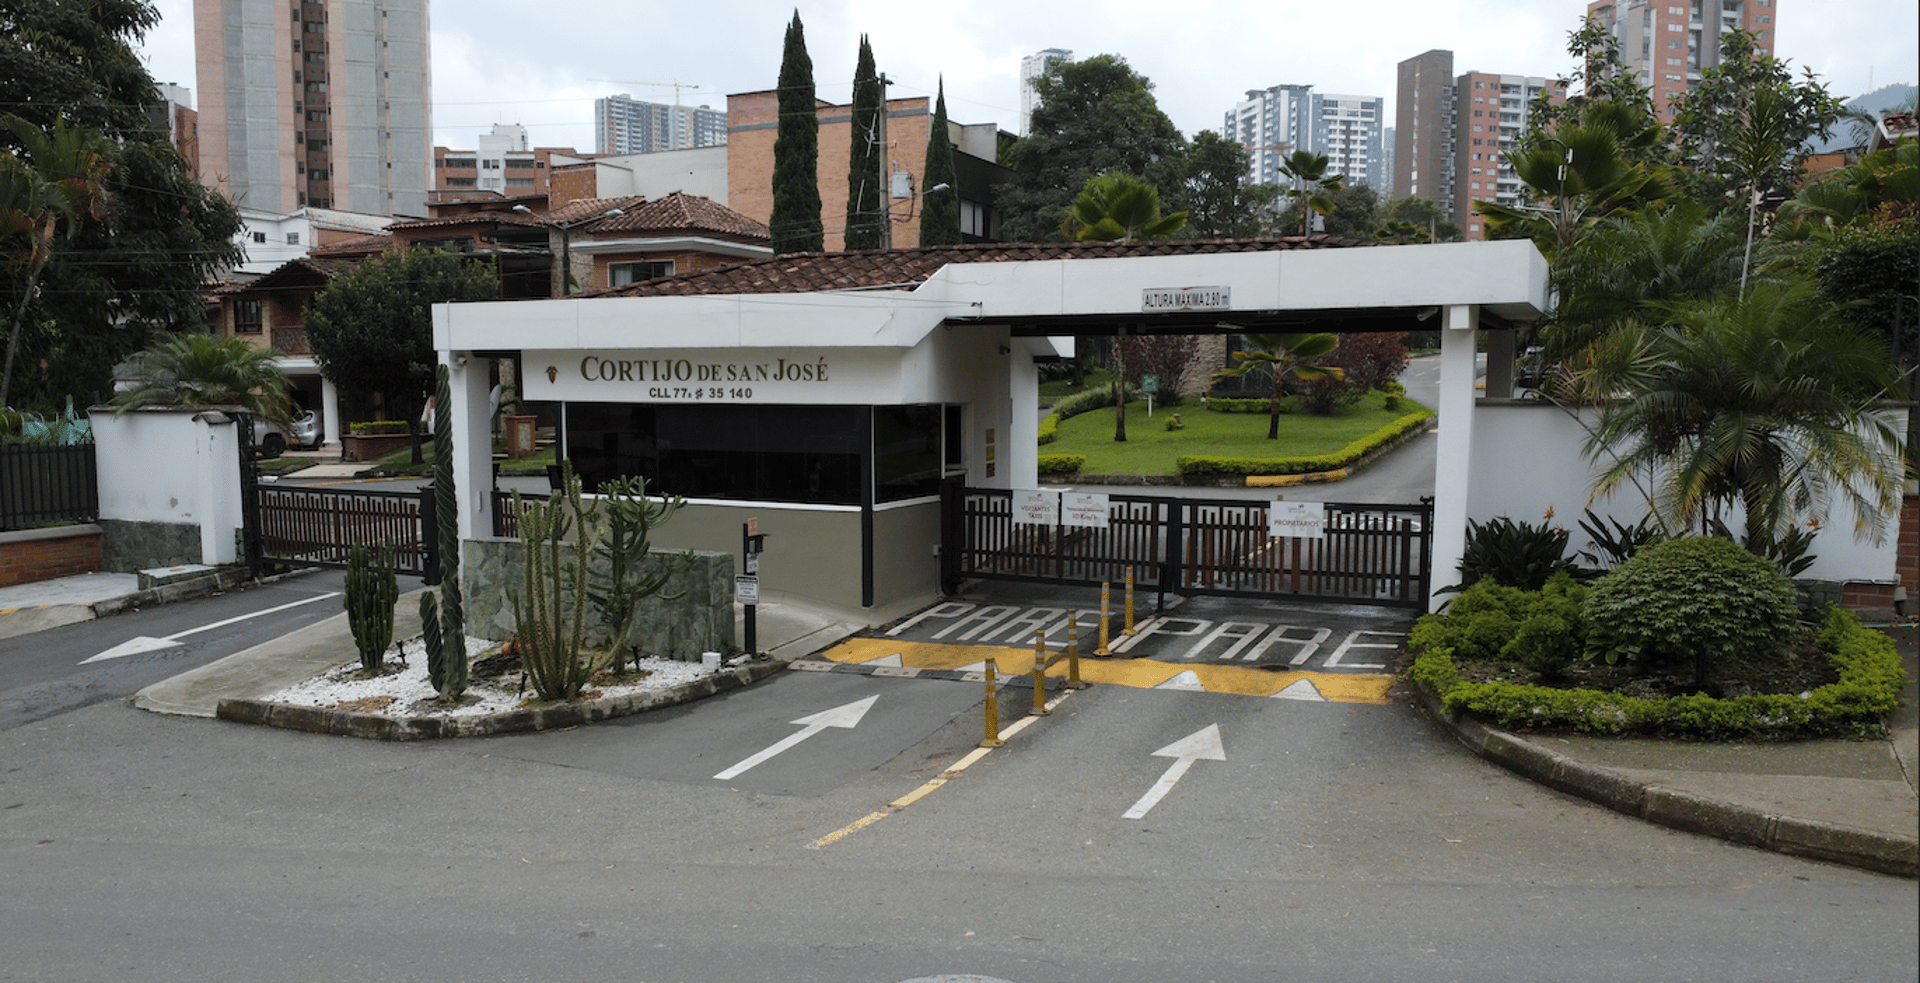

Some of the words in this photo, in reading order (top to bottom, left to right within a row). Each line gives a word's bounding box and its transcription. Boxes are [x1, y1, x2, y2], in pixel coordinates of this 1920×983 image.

[1144, 293, 1175, 308] ALTURA
[580, 356, 692, 382] CORTIJO
[697, 363, 722, 382] DE
[726, 363, 769, 382] SAN
[773, 356, 829, 382] JOSÉ
[649, 387, 671, 399] CLL
[708, 387, 724, 399] 35
[729, 387, 753, 399] 140
[1273, 519, 1320, 527] PROPIETARIOS
[884, 602, 1116, 648] PARE
[1114, 616, 1406, 669] PARE
